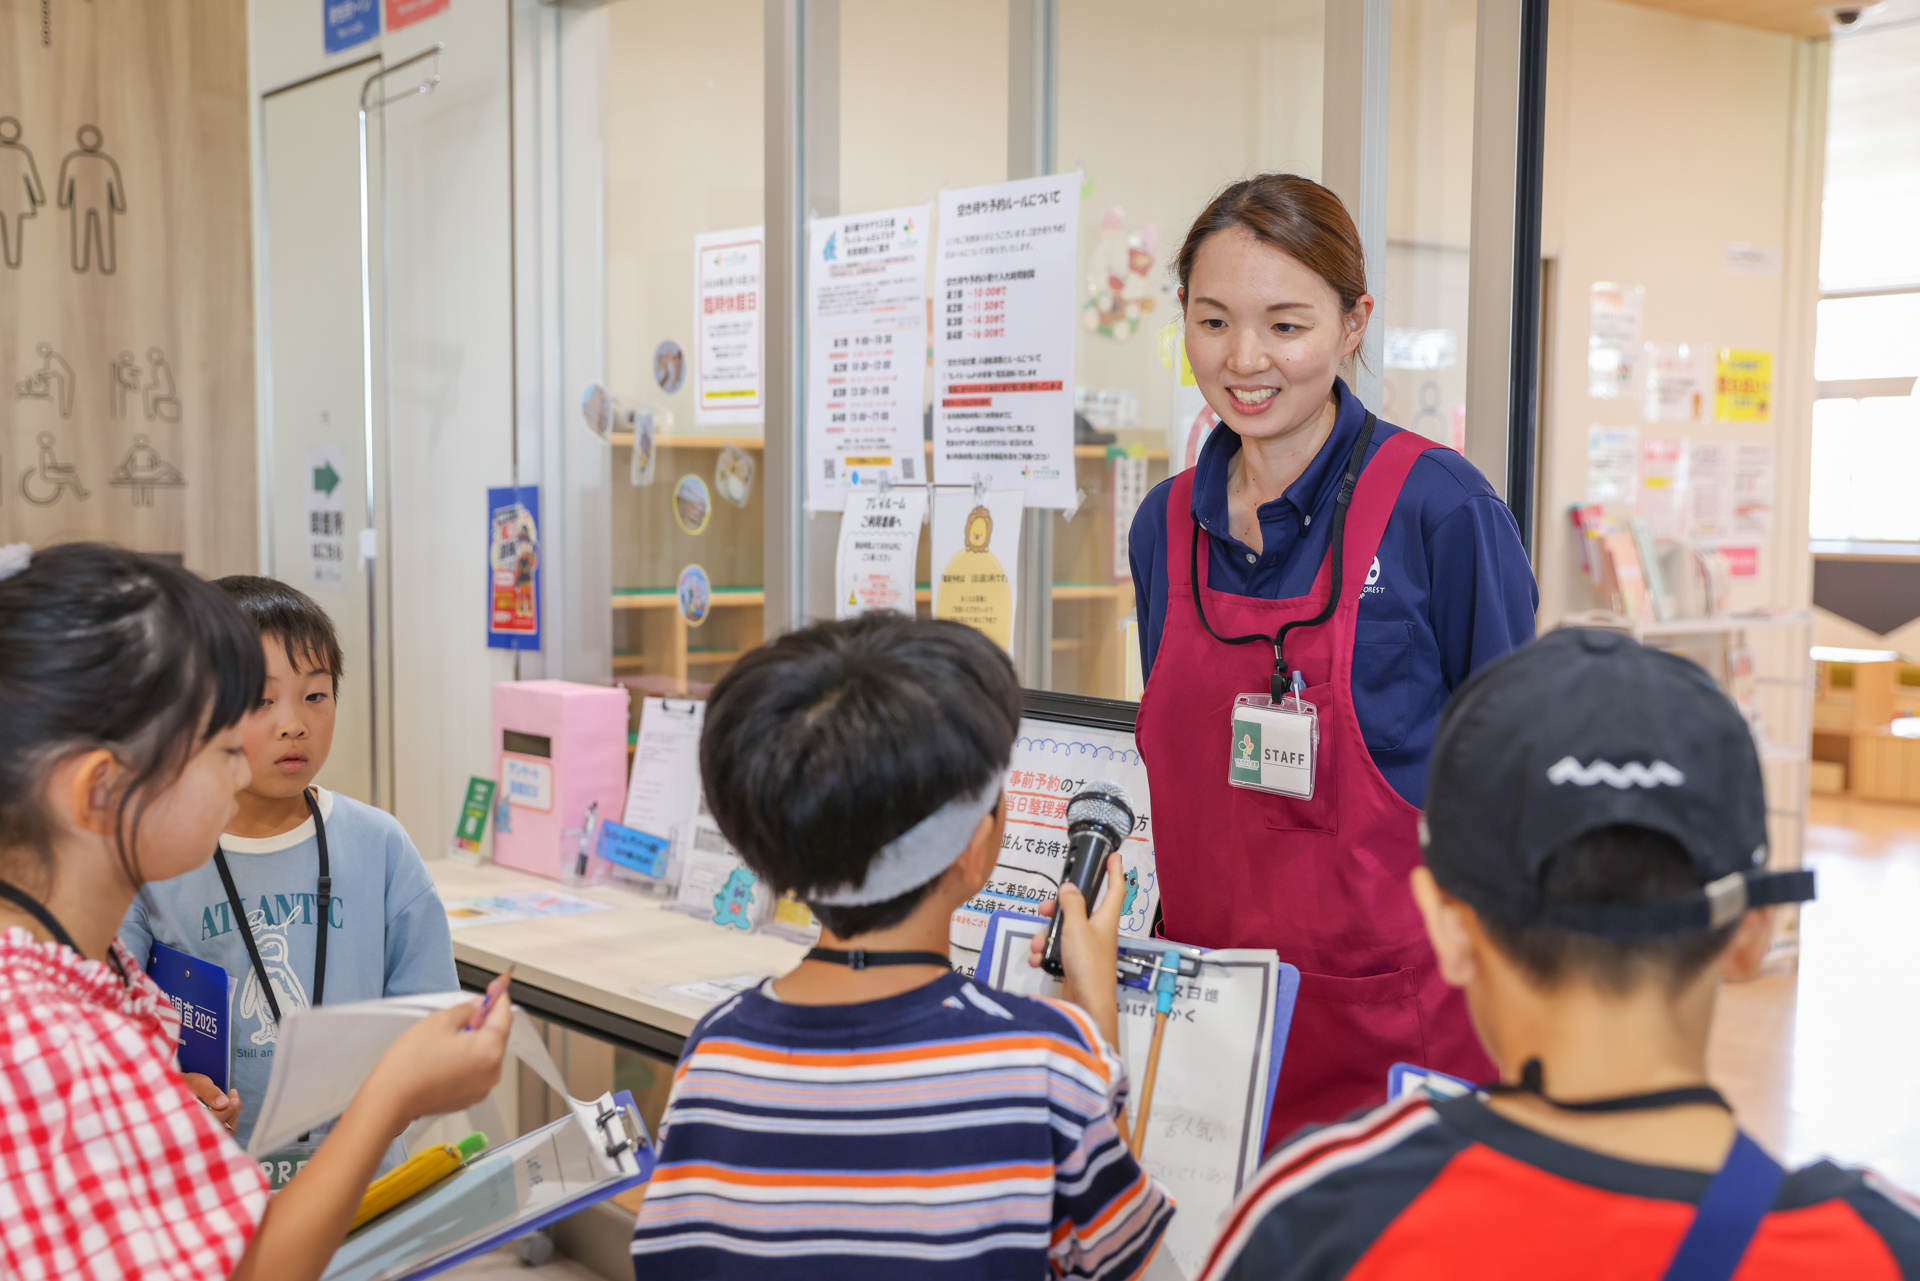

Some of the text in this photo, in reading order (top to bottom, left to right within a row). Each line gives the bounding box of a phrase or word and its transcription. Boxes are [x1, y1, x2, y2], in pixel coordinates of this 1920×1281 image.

[865, 497, 906, 510] プレイルーム
[1264, 748, 1305, 766] STAFF
[1005, 794, 1150, 832] 当日整理券 方
[201, 892, 343, 941] ATANTC
[194, 1011, 217, 1035] 2025
[236, 1048, 258, 1059] Still
